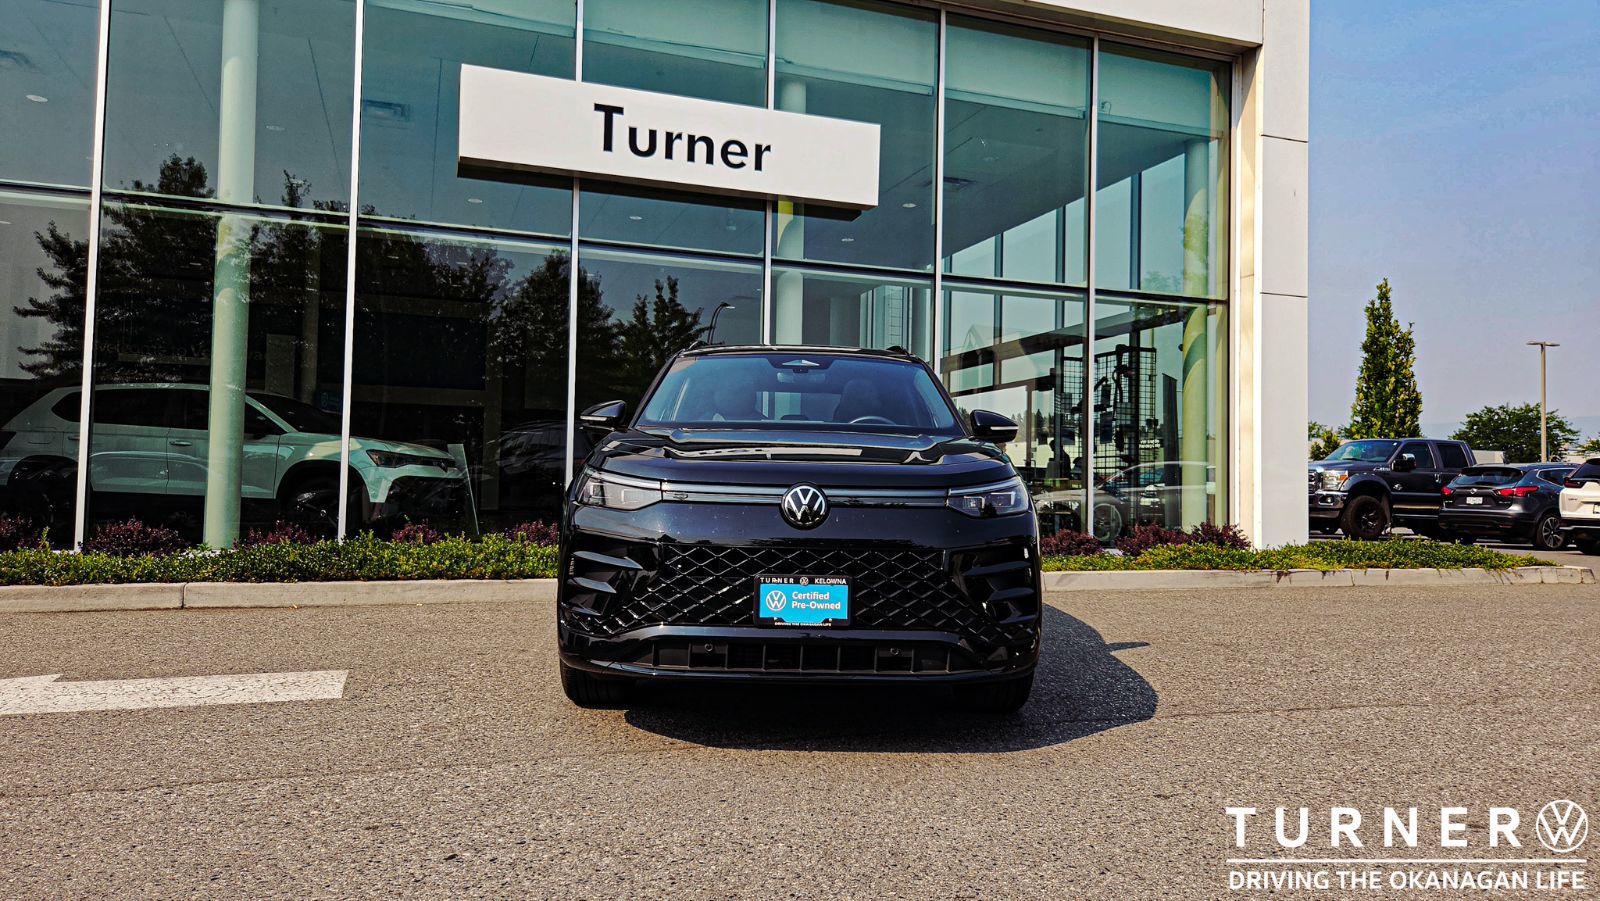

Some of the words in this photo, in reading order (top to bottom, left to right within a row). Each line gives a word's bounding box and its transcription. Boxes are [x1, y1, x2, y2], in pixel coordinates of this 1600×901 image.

[594, 102, 772, 172] Turner
[792, 591, 830, 600] Certified
[791, 601, 841, 610] Pre-Owned
